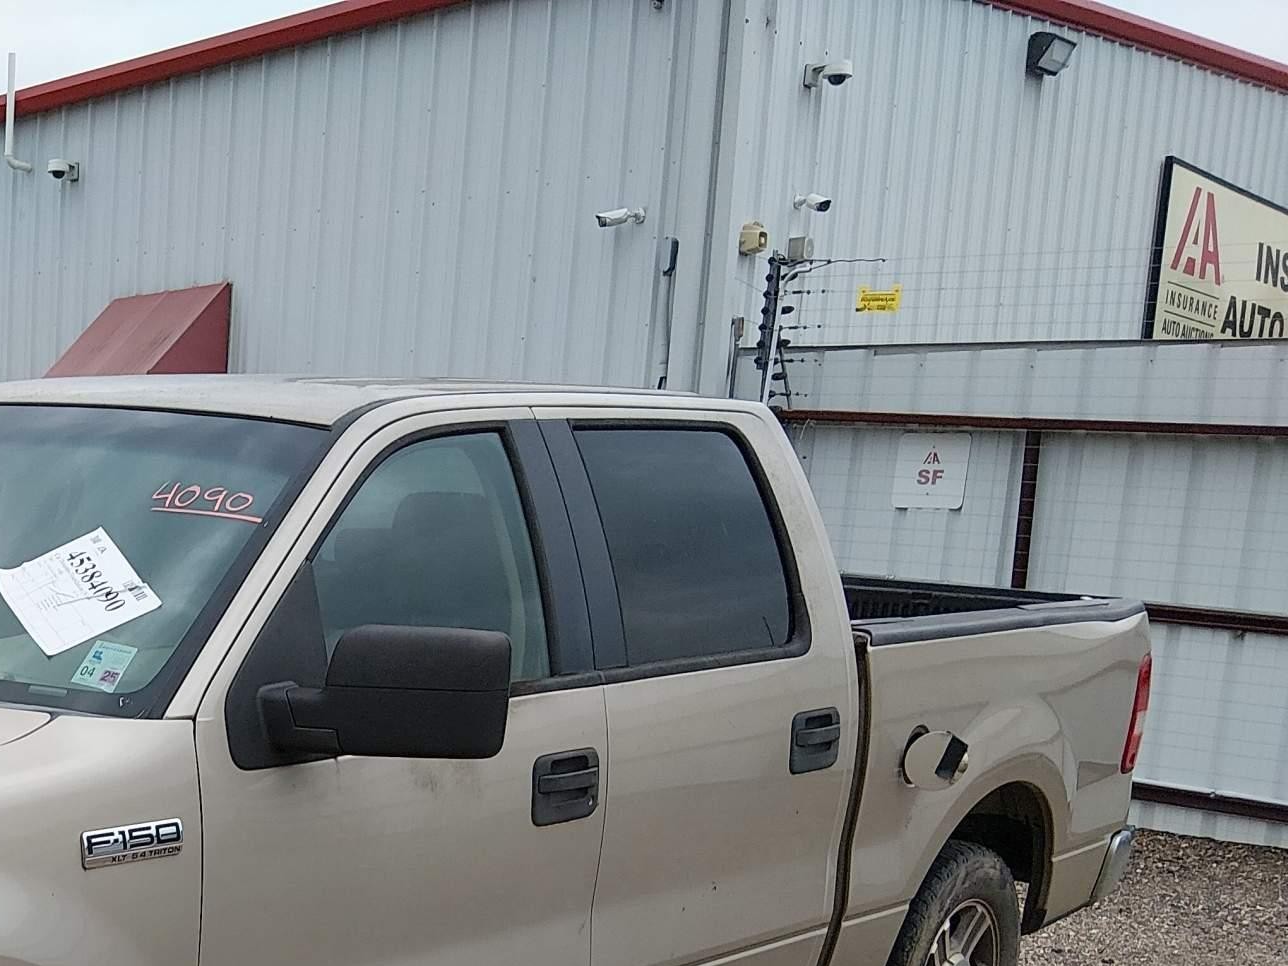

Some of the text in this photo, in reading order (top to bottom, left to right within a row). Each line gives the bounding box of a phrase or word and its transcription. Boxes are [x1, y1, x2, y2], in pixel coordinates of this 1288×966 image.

[1165, 288, 1219, 321] INSURANCE
[1220, 295, 1285, 338] AUTO
[1161, 317, 1181, 338] AUTO
[916, 469, 945, 486] SF
[151, 480, 254, 512] 4090
[66, 550, 127, 613] 45384090
[79, 665, 96, 678] 04
[99, 670, 120, 683] 25
[86, 822, 181, 856] F-150
[111, 854, 128, 864] XLT
[149, 844, 181, 857] TRITON
